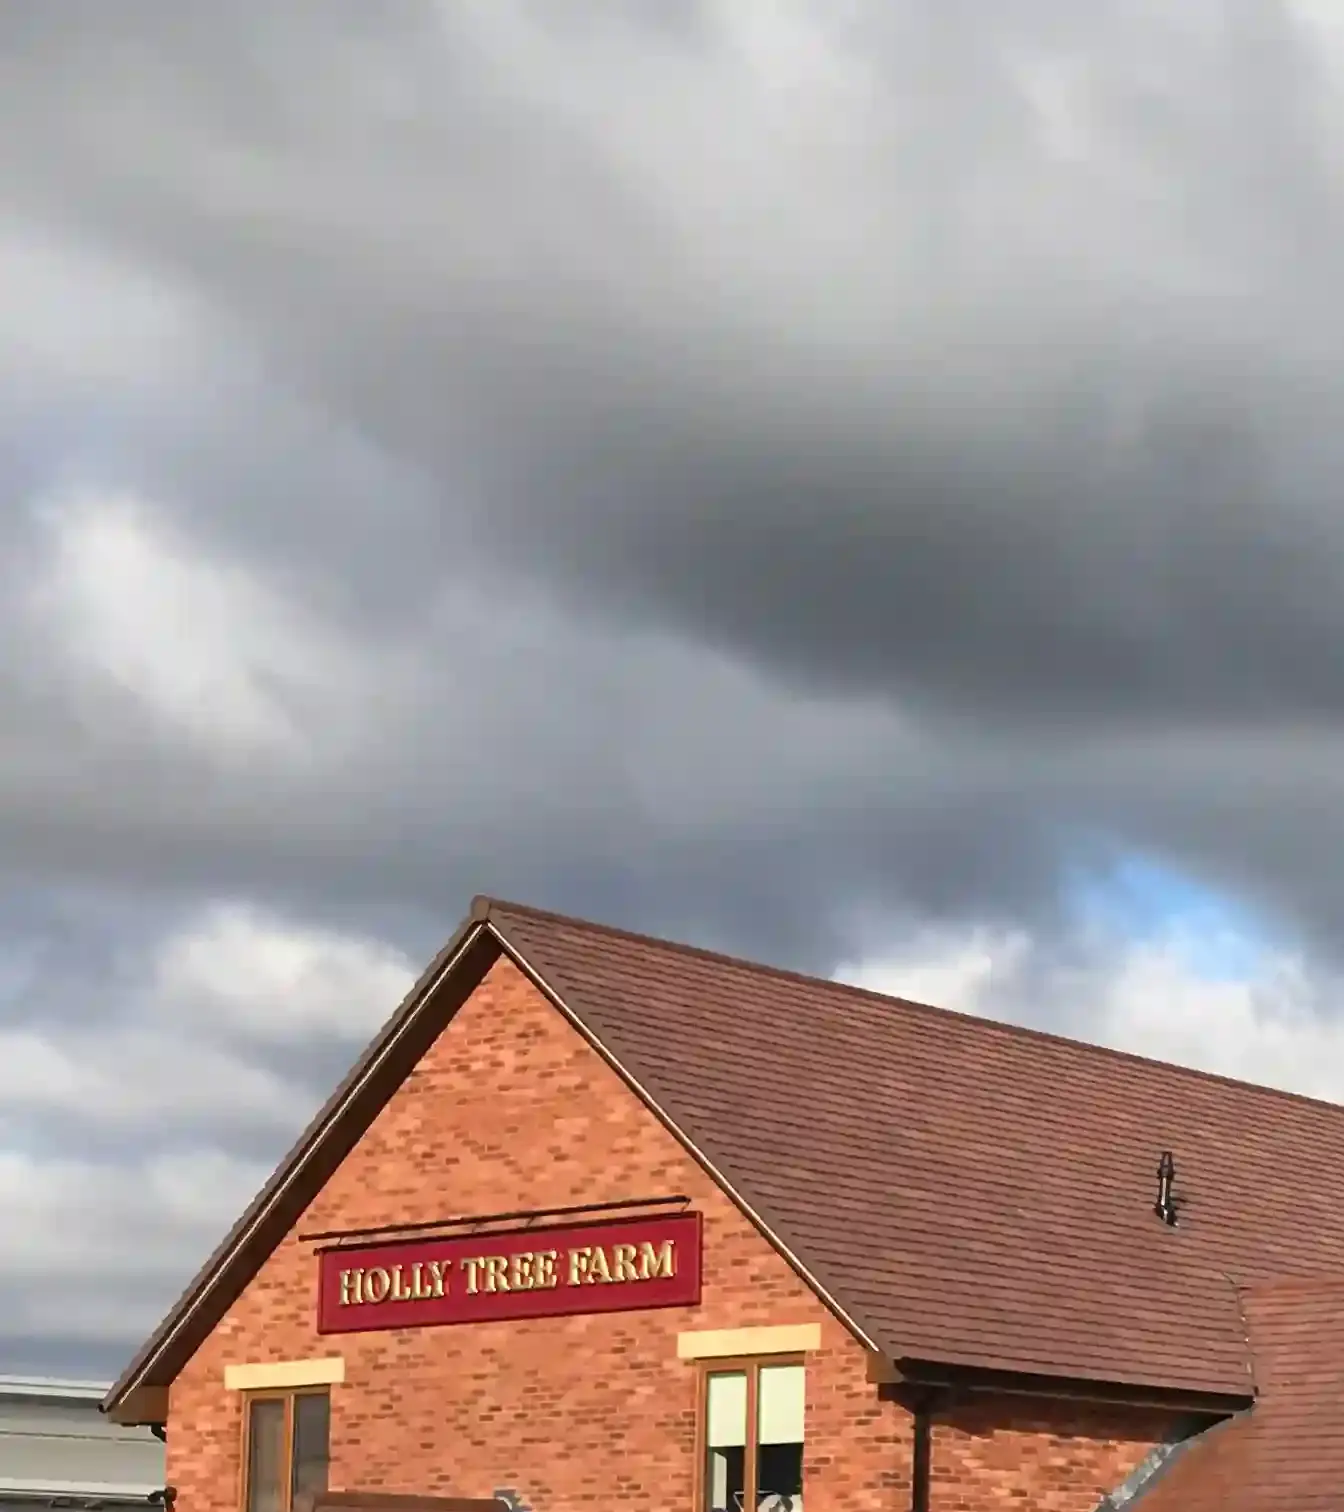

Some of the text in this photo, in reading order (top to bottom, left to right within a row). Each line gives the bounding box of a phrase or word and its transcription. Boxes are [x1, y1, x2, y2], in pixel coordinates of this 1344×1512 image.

[338, 1239, 675, 1306] HOLLY TREE FARM
